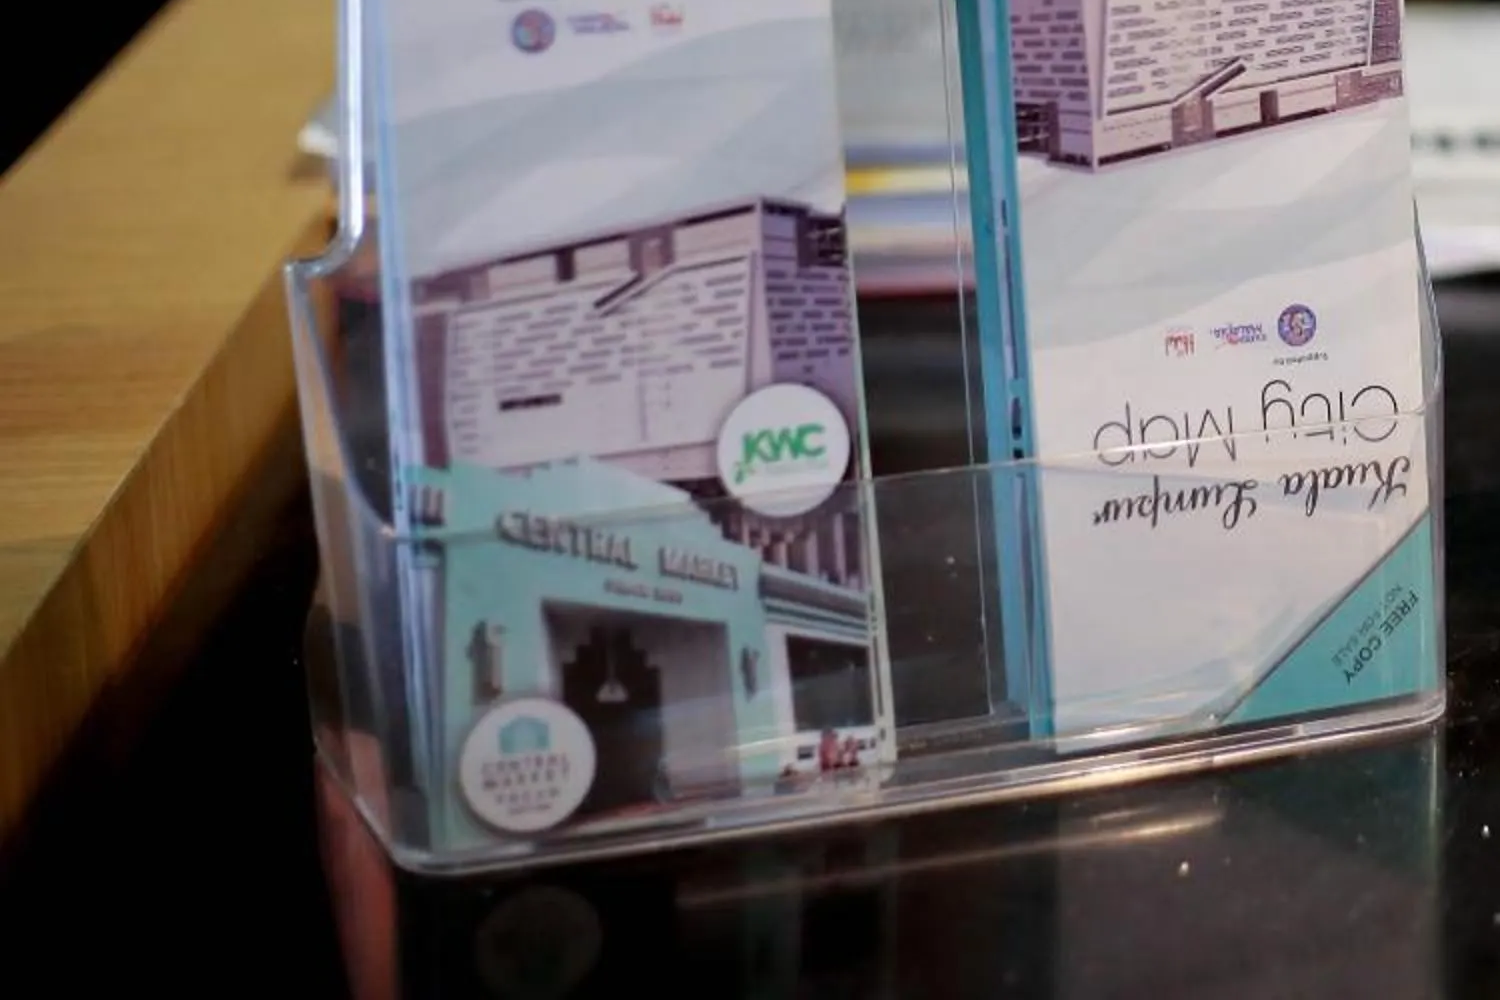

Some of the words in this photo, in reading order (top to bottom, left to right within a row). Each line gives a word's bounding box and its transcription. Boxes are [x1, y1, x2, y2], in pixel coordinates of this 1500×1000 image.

[1094, 401, 1238, 467] Map
[1261, 379, 1399, 444] City
[742, 422, 827, 464] KWC
[1094, 474, 1258, 530] Lumpur
[1279, 455, 1411, 517] Kuala
[1380, 589, 1419, 638] FREE
[1343, 636, 1382, 686] COPY
